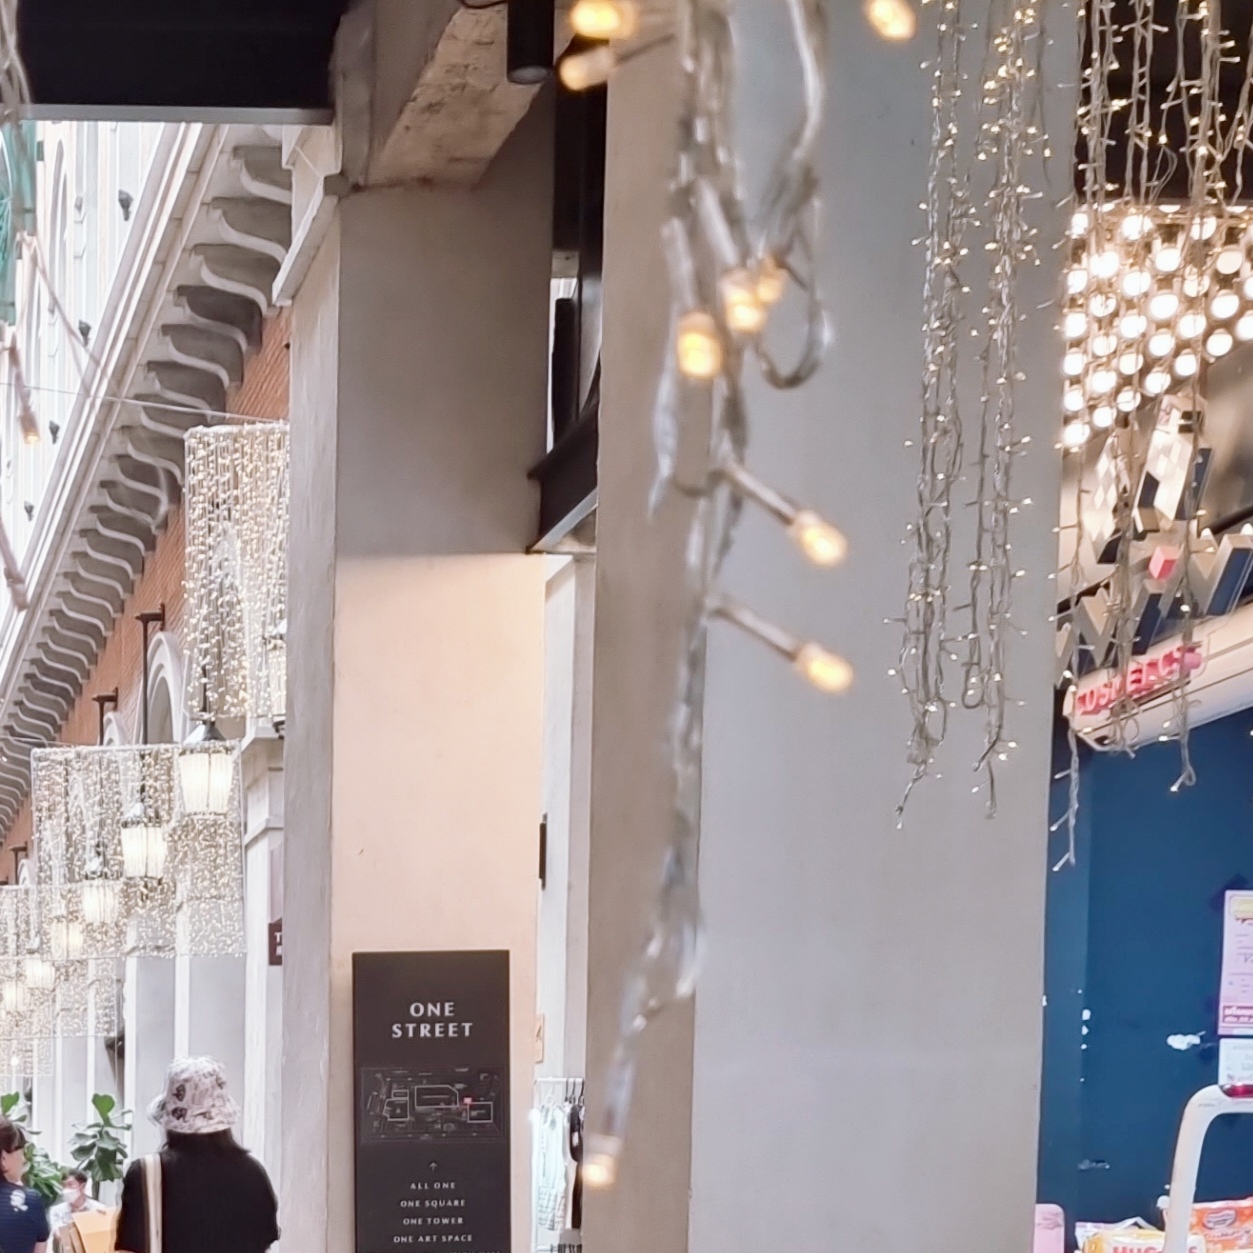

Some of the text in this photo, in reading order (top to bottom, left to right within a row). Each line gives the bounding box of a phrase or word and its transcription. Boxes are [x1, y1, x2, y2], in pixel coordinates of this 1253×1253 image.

[409, 1002, 455, 1017] ONE
[391, 1022, 473, 1038] STREET
[410, 1182, 456, 1190] ALL ONE
[400, 1199, 466, 1209] ONE SQUARE
[403, 1217, 464, 1225] ONE TOWER
[393, 1234, 473, 1243] ONE ART SPACE
